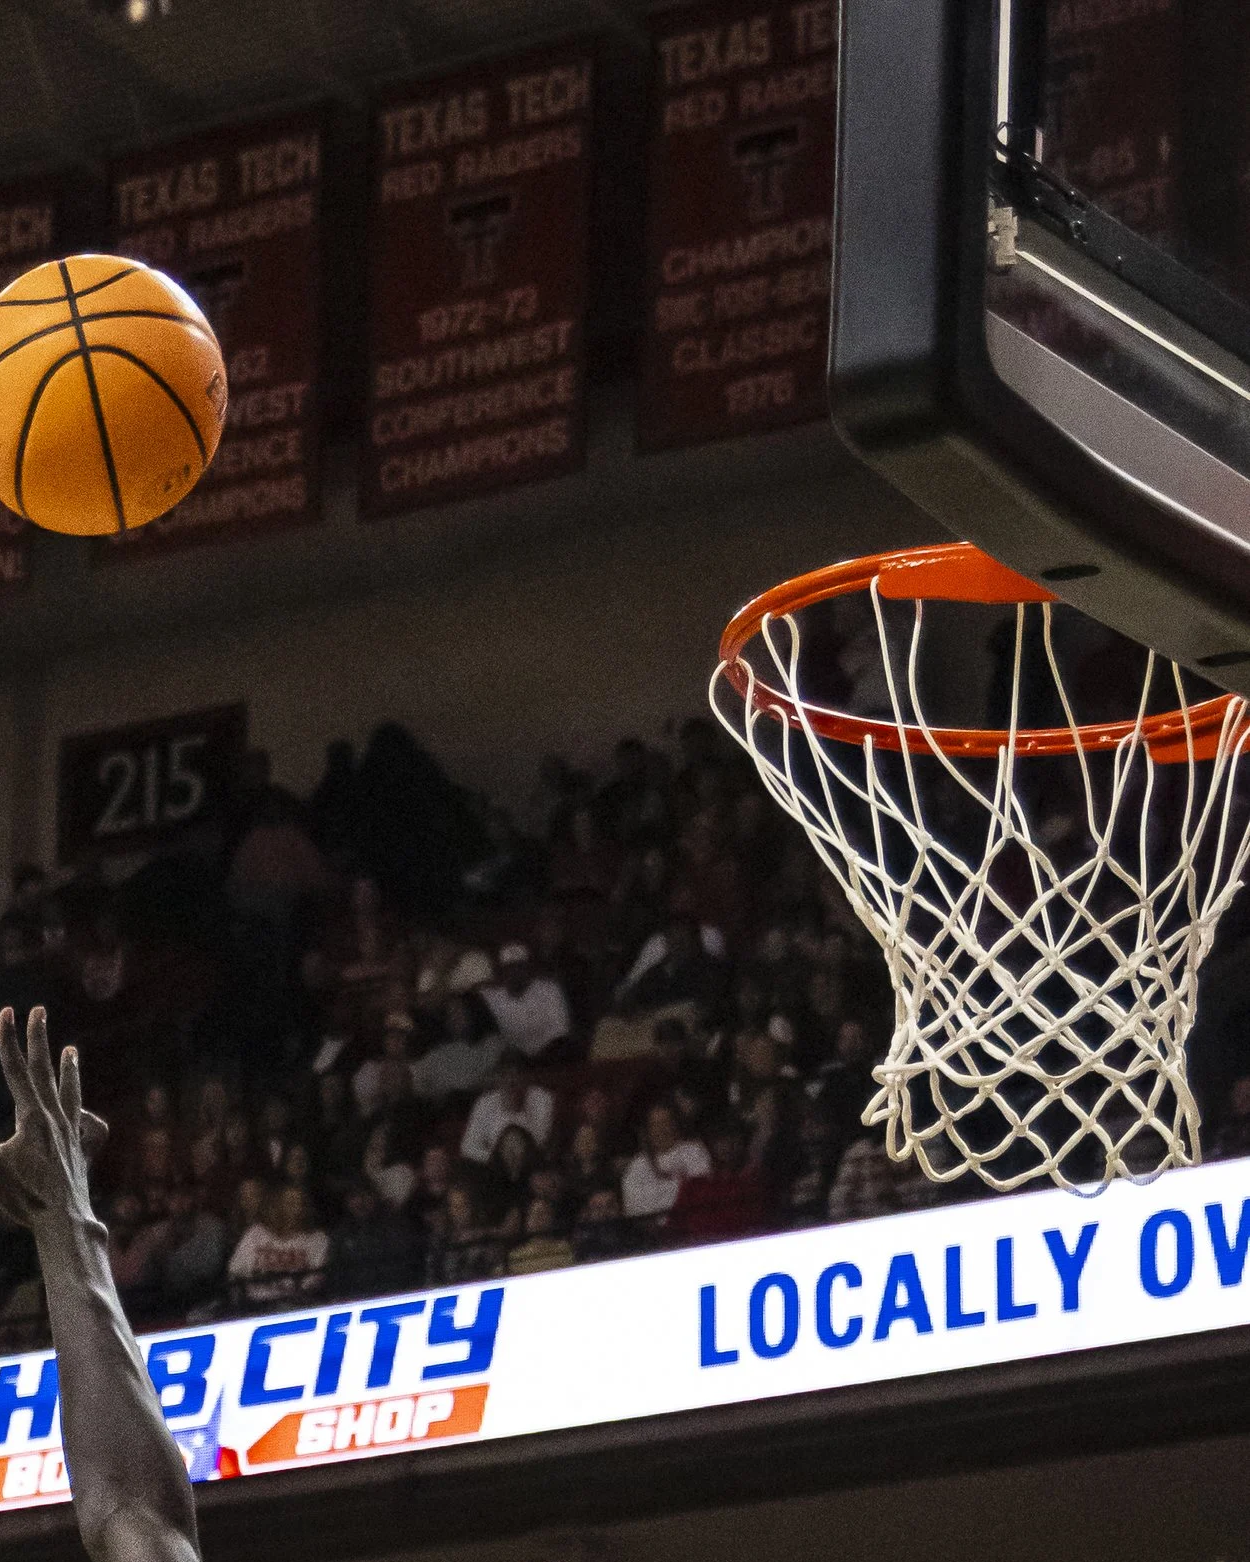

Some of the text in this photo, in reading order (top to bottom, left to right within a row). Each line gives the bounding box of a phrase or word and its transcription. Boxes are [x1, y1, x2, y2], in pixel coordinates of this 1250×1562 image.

[658, 0, 833, 86] TEXAS TE
[381, 63, 589, 157] TEXAS TECH
[663, 62, 831, 134] RED RAIDE
[116, 134, 318, 222] TEXAS TECH
[382, 125, 582, 202] RED RAIDERS
[188, 194, 311, 249] RAIDERS
[662, 216, 828, 284] CHAMPION
[419, 286, 537, 341] 1972-73
[673, 312, 817, 375] CLASSIC
[376, 321, 573, 397] SOUTHWEST
[372, 368, 575, 444] CONFERENCE
[380, 418, 568, 490] CHAMPIONS
[94, 734, 206, 838] 215
[699, 1222, 1099, 1367] LOCALLY
[239, 1287, 505, 1407] CITY
[295, 1393, 454, 1456] SHOP
[2, 1450, 71, 1500] BO
